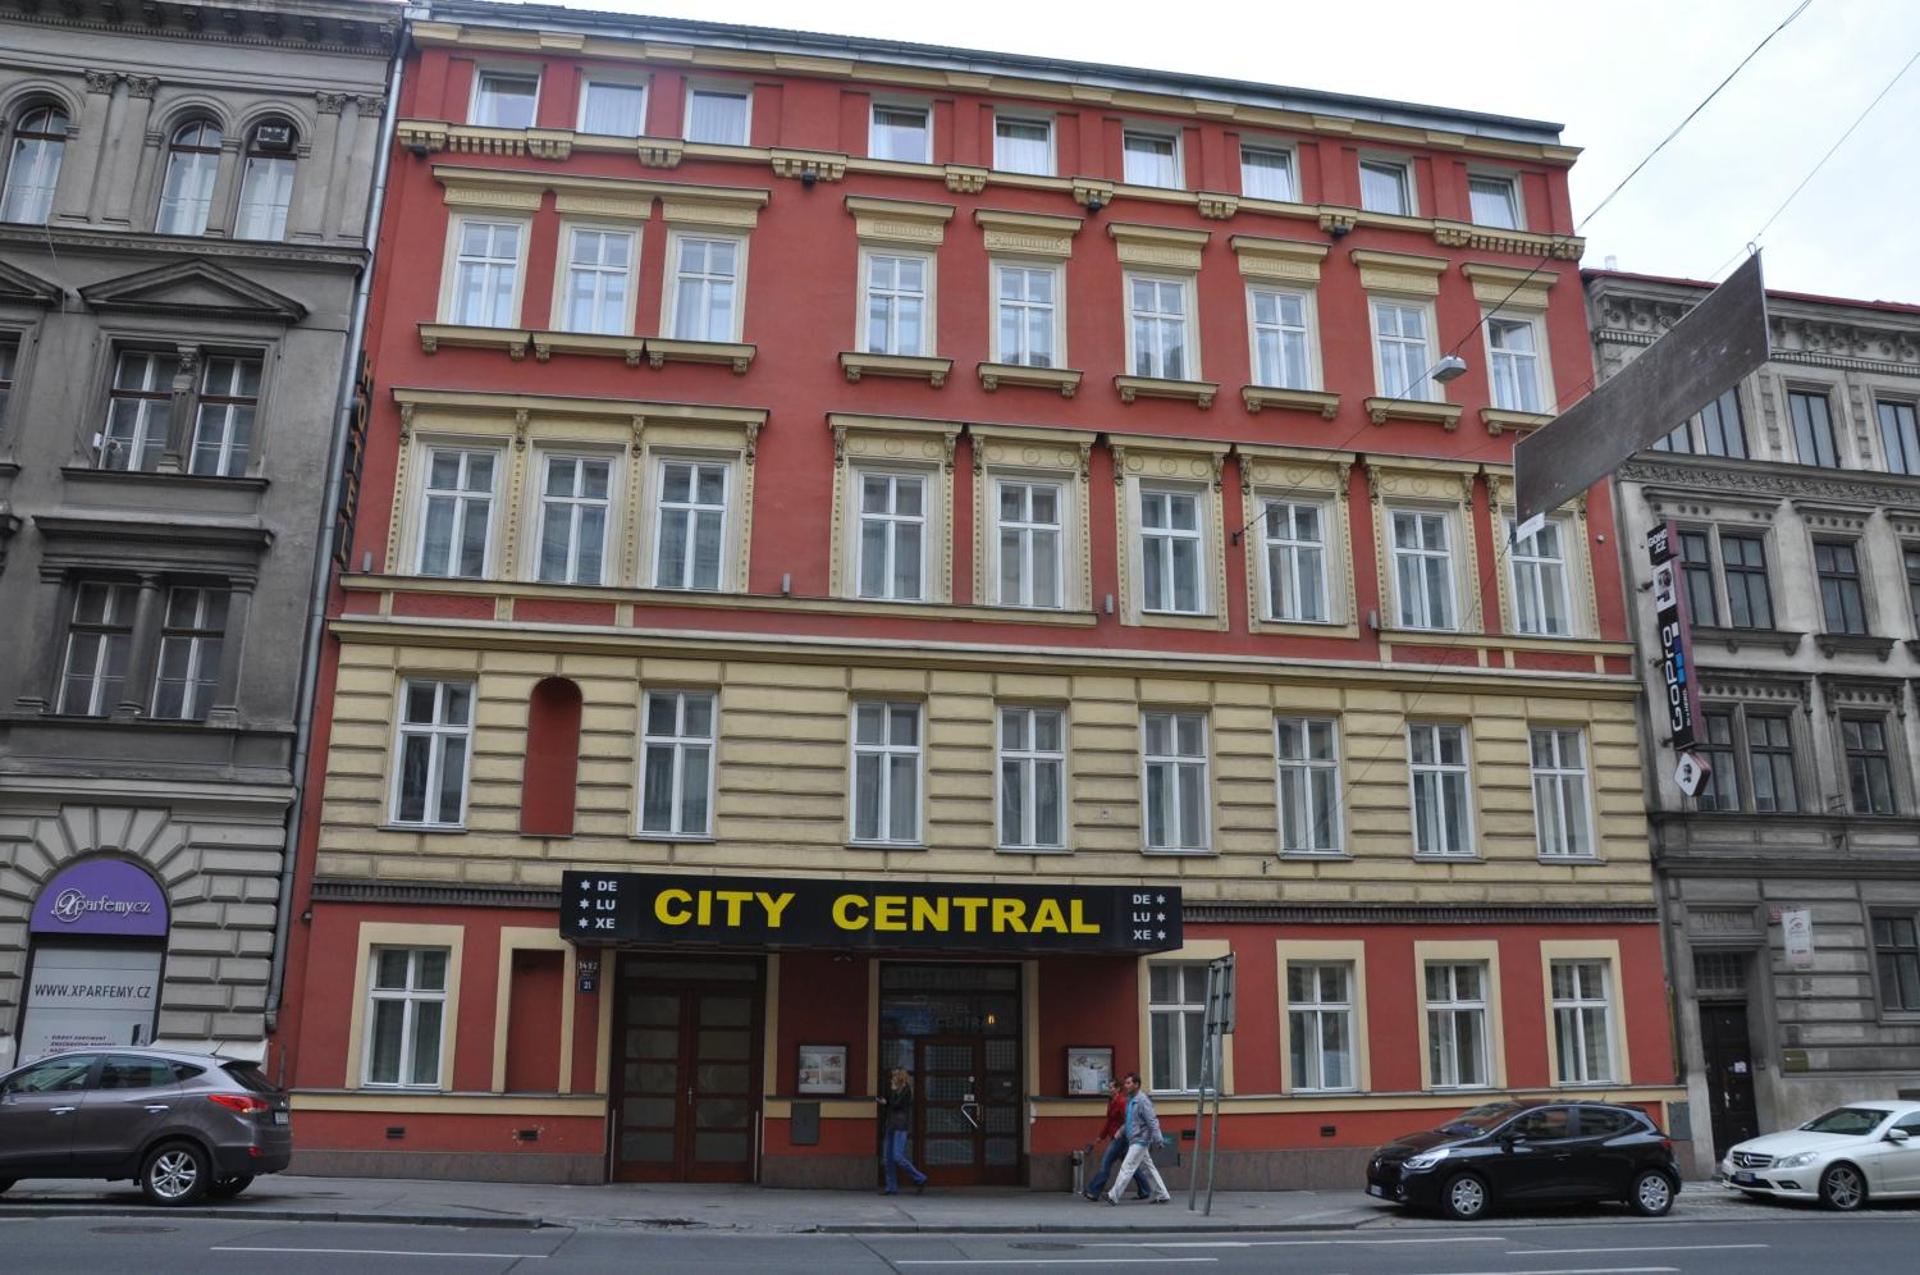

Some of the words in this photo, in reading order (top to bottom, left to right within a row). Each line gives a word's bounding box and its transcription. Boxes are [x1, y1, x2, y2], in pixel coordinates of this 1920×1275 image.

[338, 354, 372, 563] HOTEL
[1663, 625, 1683, 732] GoPro
[597, 880, 618, 891] DE
[596, 899, 616, 910] LU
[1133, 894, 1151, 904] DE
[654, 888, 796, 928] CITY
[832, 894, 1101, 934] CENTRAL
[1133, 912, 1150, 922] LU
[595, 917, 616, 929] XE
[1133, 930, 1151, 940] XE
[35, 984, 152, 998] WWW.XPARFEMY.CZ
